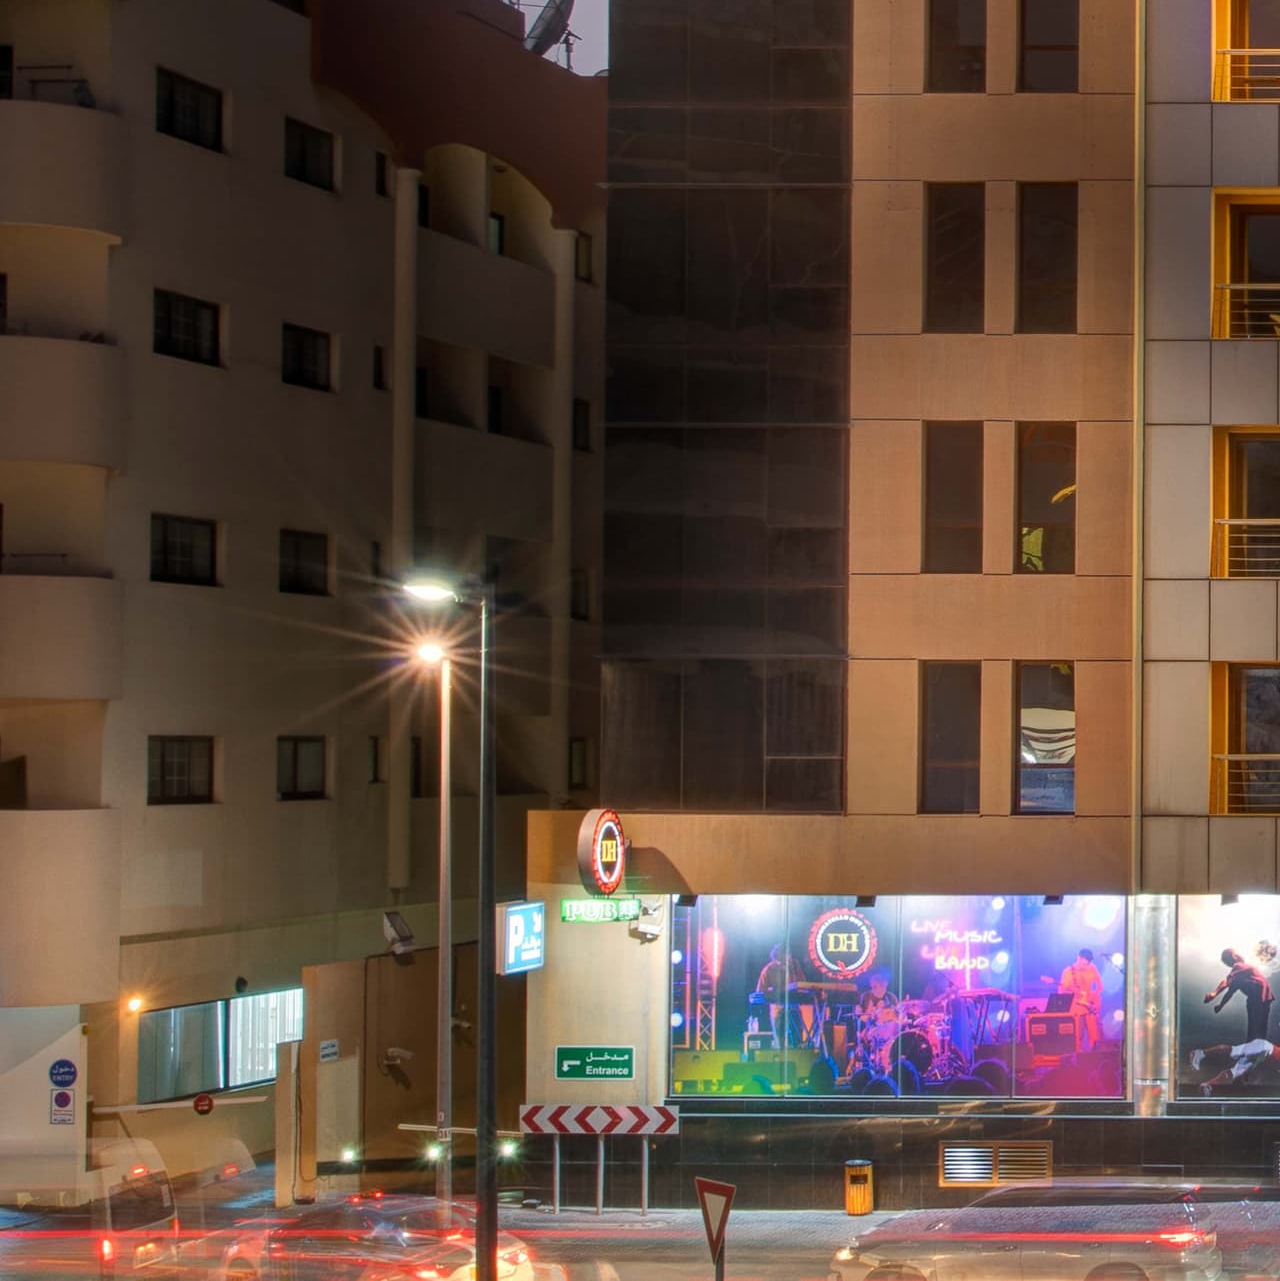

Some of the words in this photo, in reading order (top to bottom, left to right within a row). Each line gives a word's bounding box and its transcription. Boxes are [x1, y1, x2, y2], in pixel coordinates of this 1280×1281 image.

[601, 839, 617, 862] DH
[564, 900, 617, 921] PUB
[911, 919, 952, 933] LIVE
[508, 914, 525, 964] P
[826, 932, 859, 952] DH
[934, 930, 1002, 944] MUSIC
[934, 956, 990, 970] BAND
[585, 1051, 629, 1063] مدخل
[585, 1065, 629, 1076] Entrance
